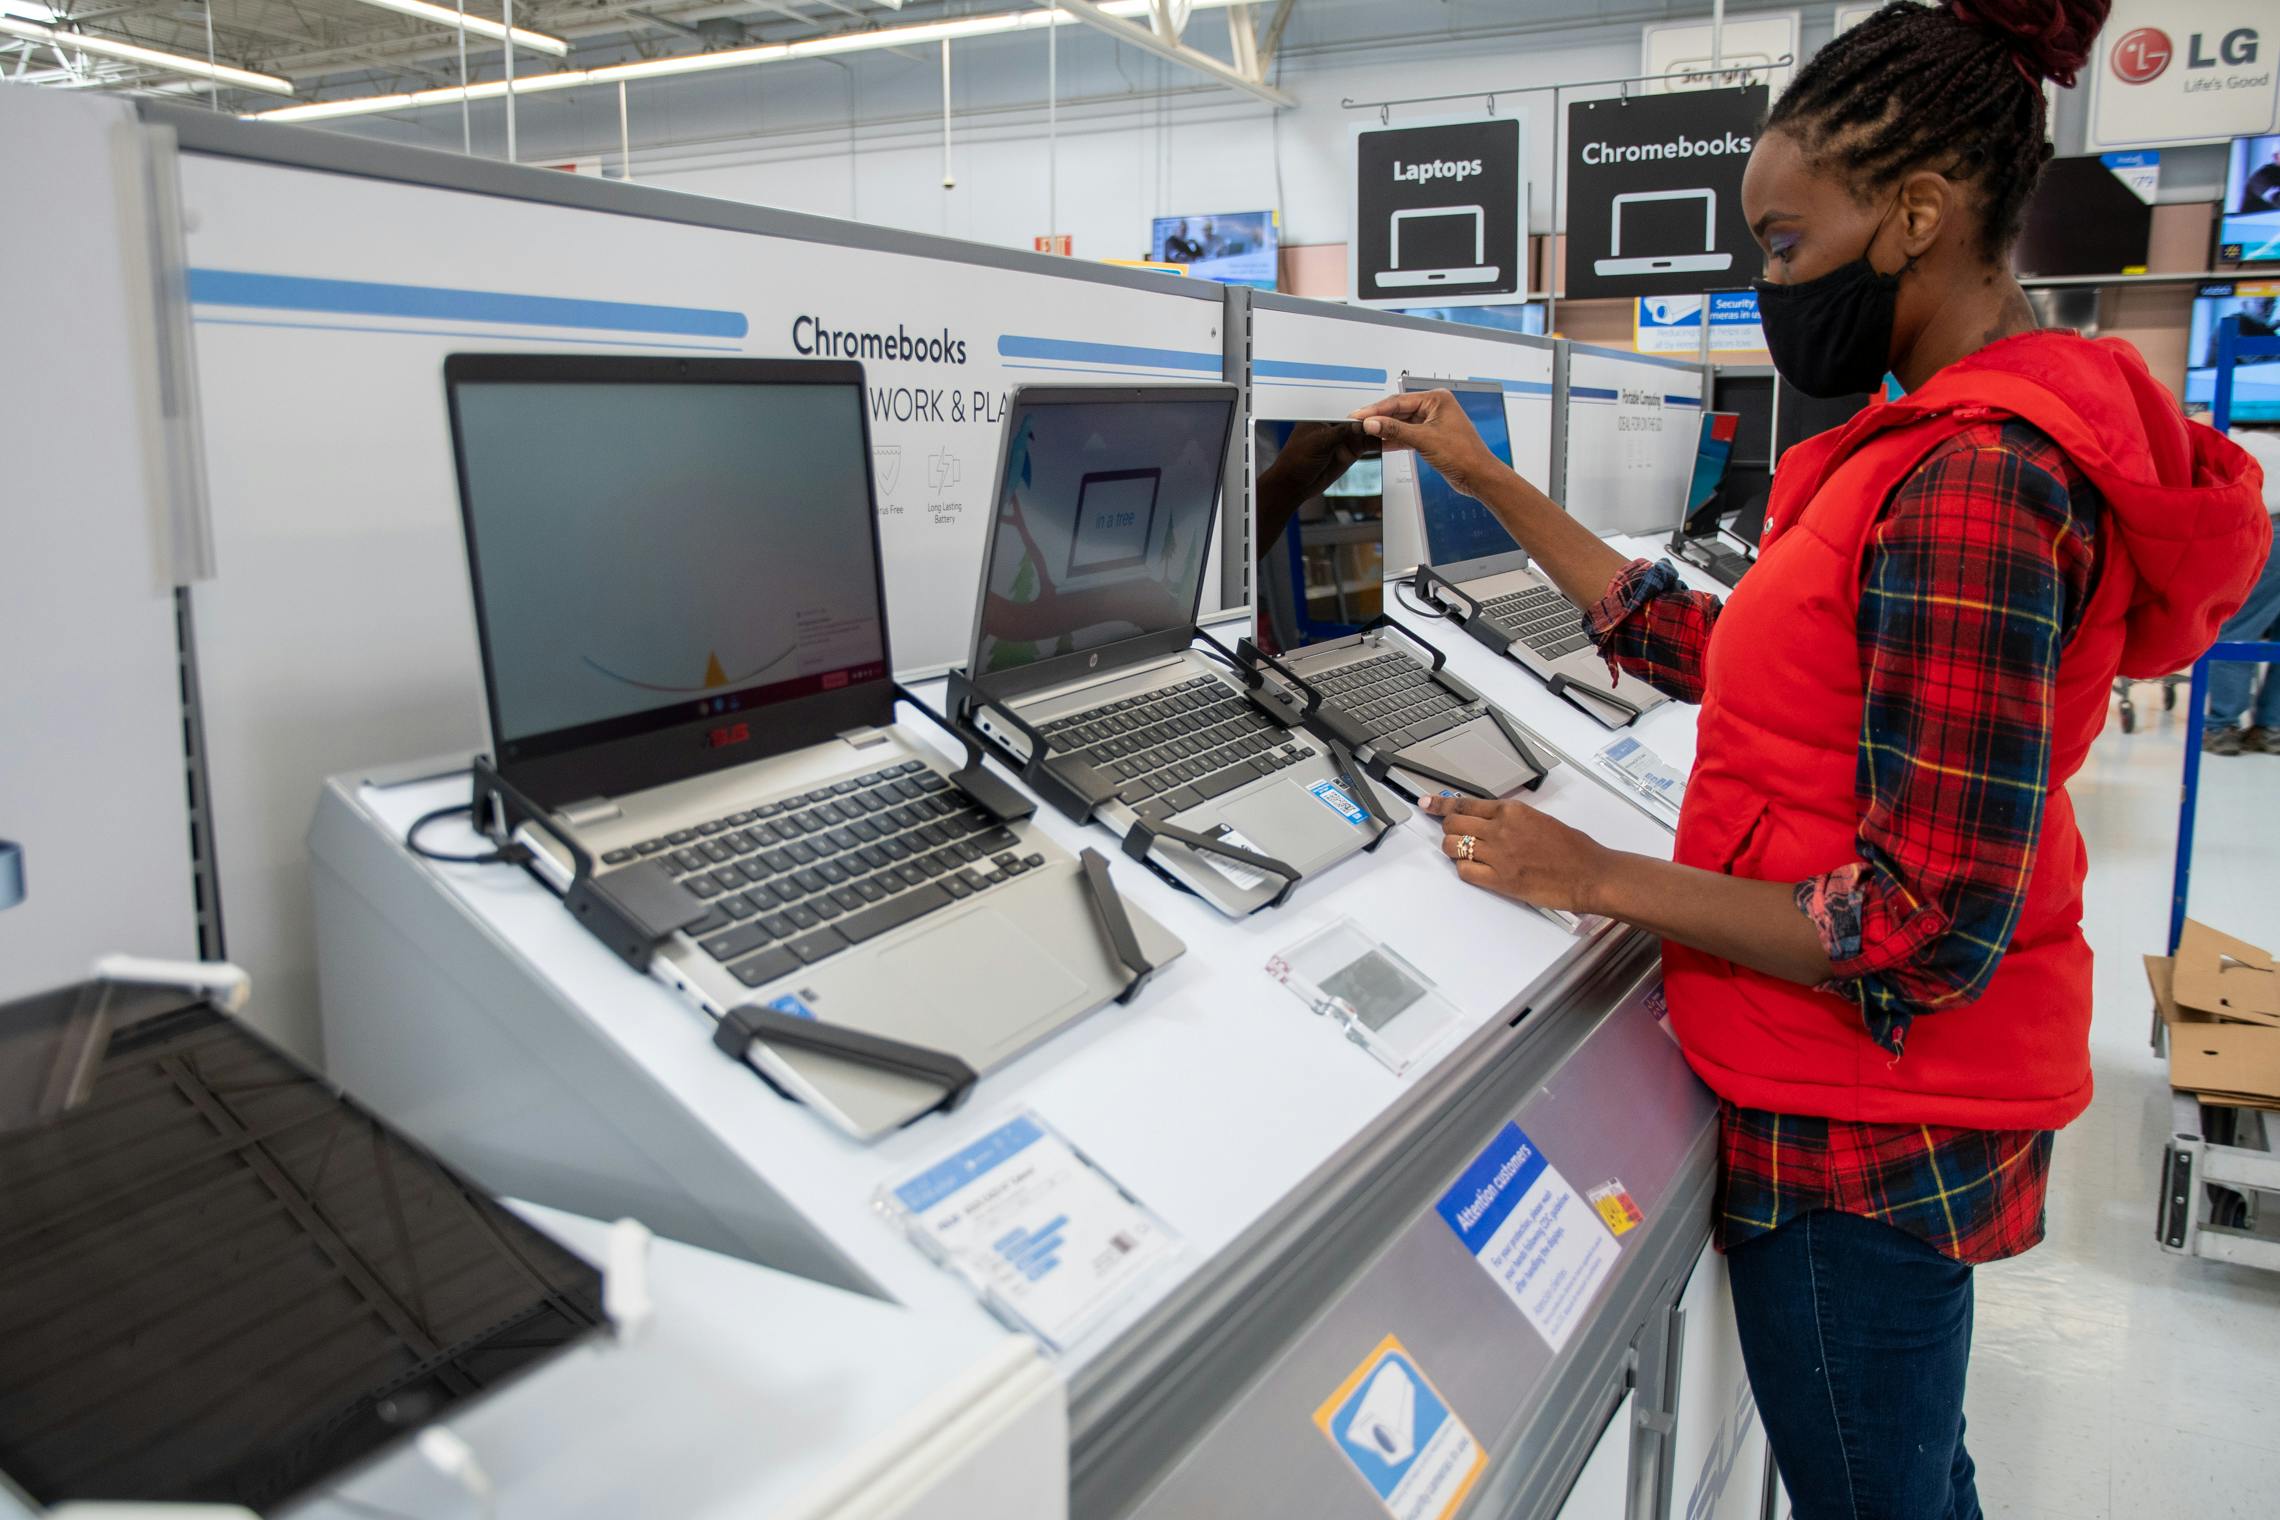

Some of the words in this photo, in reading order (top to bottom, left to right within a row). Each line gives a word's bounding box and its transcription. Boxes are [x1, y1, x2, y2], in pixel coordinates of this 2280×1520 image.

[2187, 28, 2259, 69] LG
[2184, 78, 2222, 93] Life's
[2227, 73, 2270, 89] Good
[1582, 132, 1752, 165] Chromebooks
[1393, 159, 1482, 184] Laptops
[1716, 298, 1755, 310] Security
[1709, 311, 1739, 320] meras
[792, 315, 967, 365] Chromebooks
[869, 387, 945, 422] WORK
[951, 389, 966, 423] &
[973, 391, 1007, 423] PLA
[890, 505, 904, 514] Free
[928, 503, 941, 513] Long
[943, 502, 962, 512] Lasting
[935, 515, 955, 524] Battery
[1456, 1183, 1499, 1232] Attention
[1493, 1144, 1532, 1190] customers
